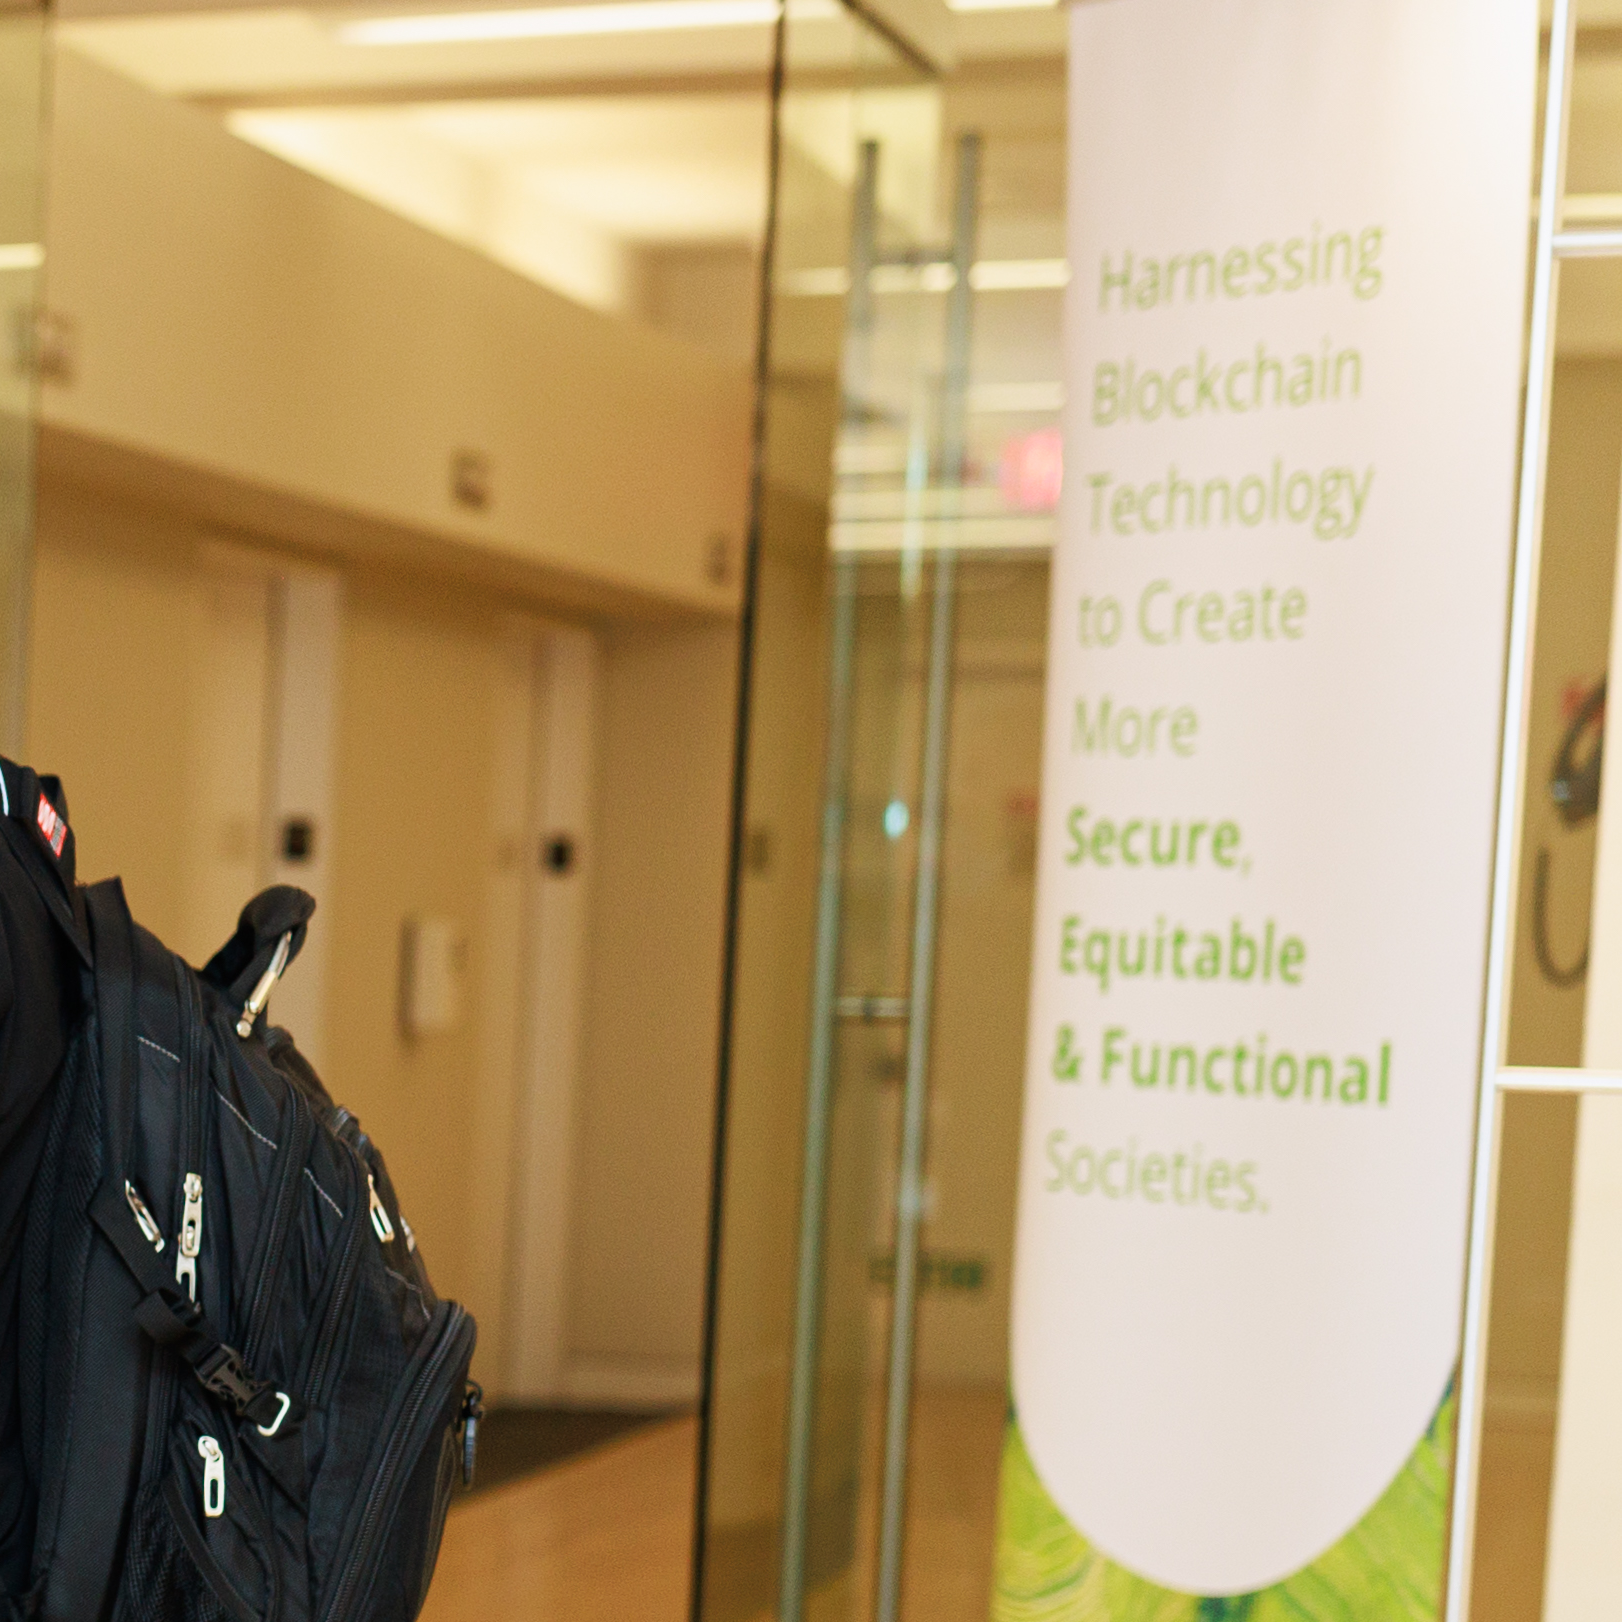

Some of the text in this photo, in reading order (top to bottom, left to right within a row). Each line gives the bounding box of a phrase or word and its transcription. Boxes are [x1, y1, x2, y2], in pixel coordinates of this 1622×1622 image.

[1098, 221, 1385, 312] Harnessing
[1092, 337, 1363, 428] Blockchain
[1087, 458, 1375, 542] Technology
[1078, 580, 1307, 647] to Create
[1070, 695, 1200, 759] More
[1064, 806, 1252, 874] Secure,
[1058, 914, 1307, 994] Equitable
[1052, 1024, 1393, 1106] & Functional
[1046, 1129, 1270, 1214] Societies.
